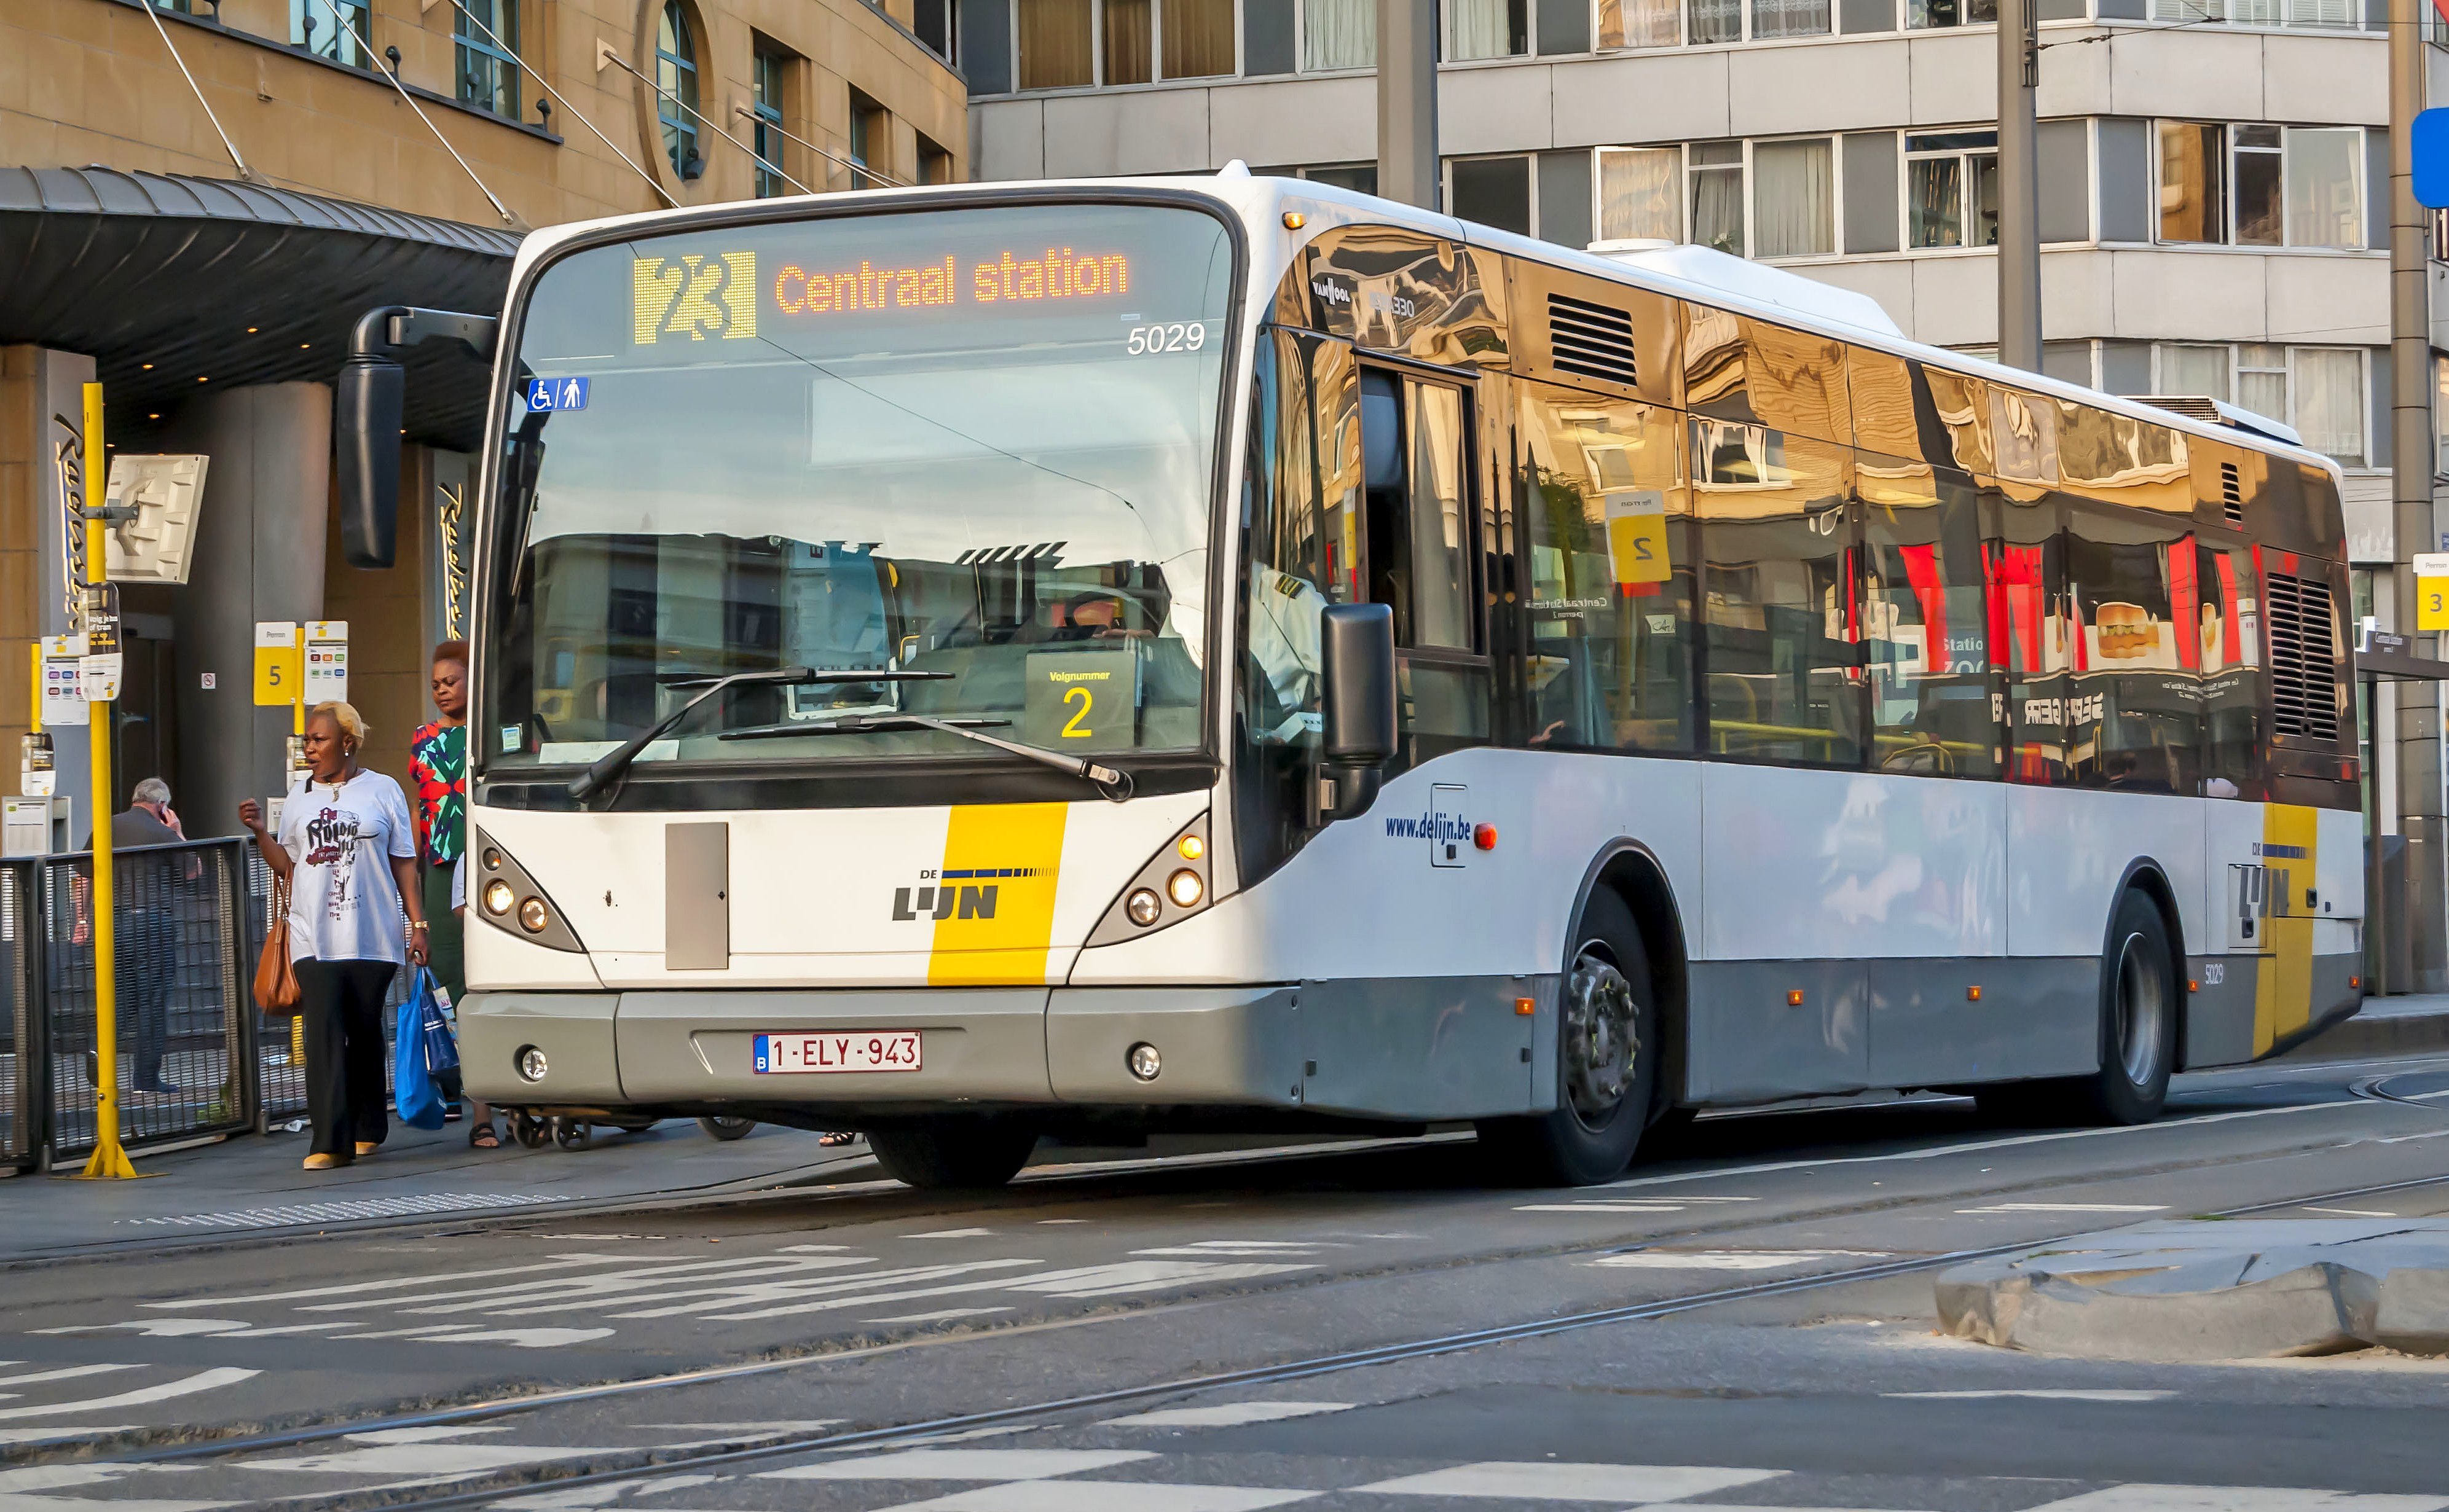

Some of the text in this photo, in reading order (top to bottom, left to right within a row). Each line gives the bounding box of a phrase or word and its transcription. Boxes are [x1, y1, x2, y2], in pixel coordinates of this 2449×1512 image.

[653, 247, 1128, 342] 23 Centraal station
[1126, 323, 1206, 355] 5029
[2430, 593, 2443, 613] 3
[1944, 637, 1983, 651] Statio
[269, 665, 281, 686] 5
[1049, 672, 1111, 683] Volgnummer
[1061, 687, 1093, 737] 2
[1386, 812, 1471, 846] www.delijn.be
[2252, 842, 2262, 856] DE
[919, 869, 938, 879] DE
[892, 885, 999, 921] LIJN
[2205, 963, 2223, 984] 5029
[757, 1038, 916, 1071] B 1-ELY-943
